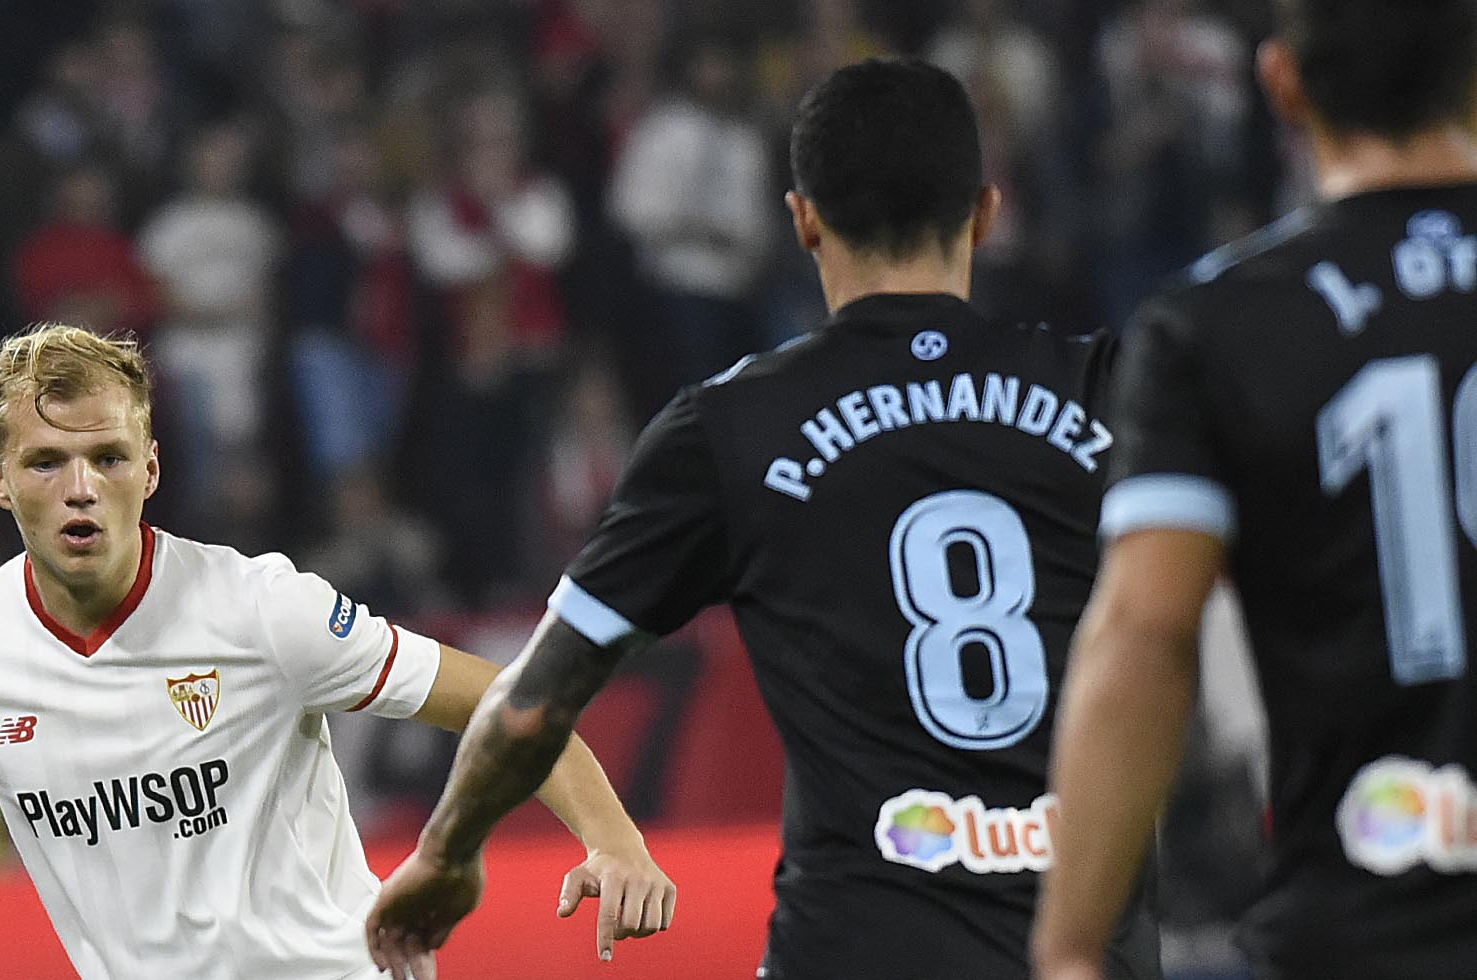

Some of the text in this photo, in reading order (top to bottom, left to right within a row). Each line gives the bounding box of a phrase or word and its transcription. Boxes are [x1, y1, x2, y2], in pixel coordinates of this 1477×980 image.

[764, 373, 1114, 502] P.HERNANDEZ
[1314, 352, 1477, 688] 1
[888, 489, 1050, 751] 8
[16, 758, 229, 847] PlayWSOP
[173, 806, 229, 840] .com
